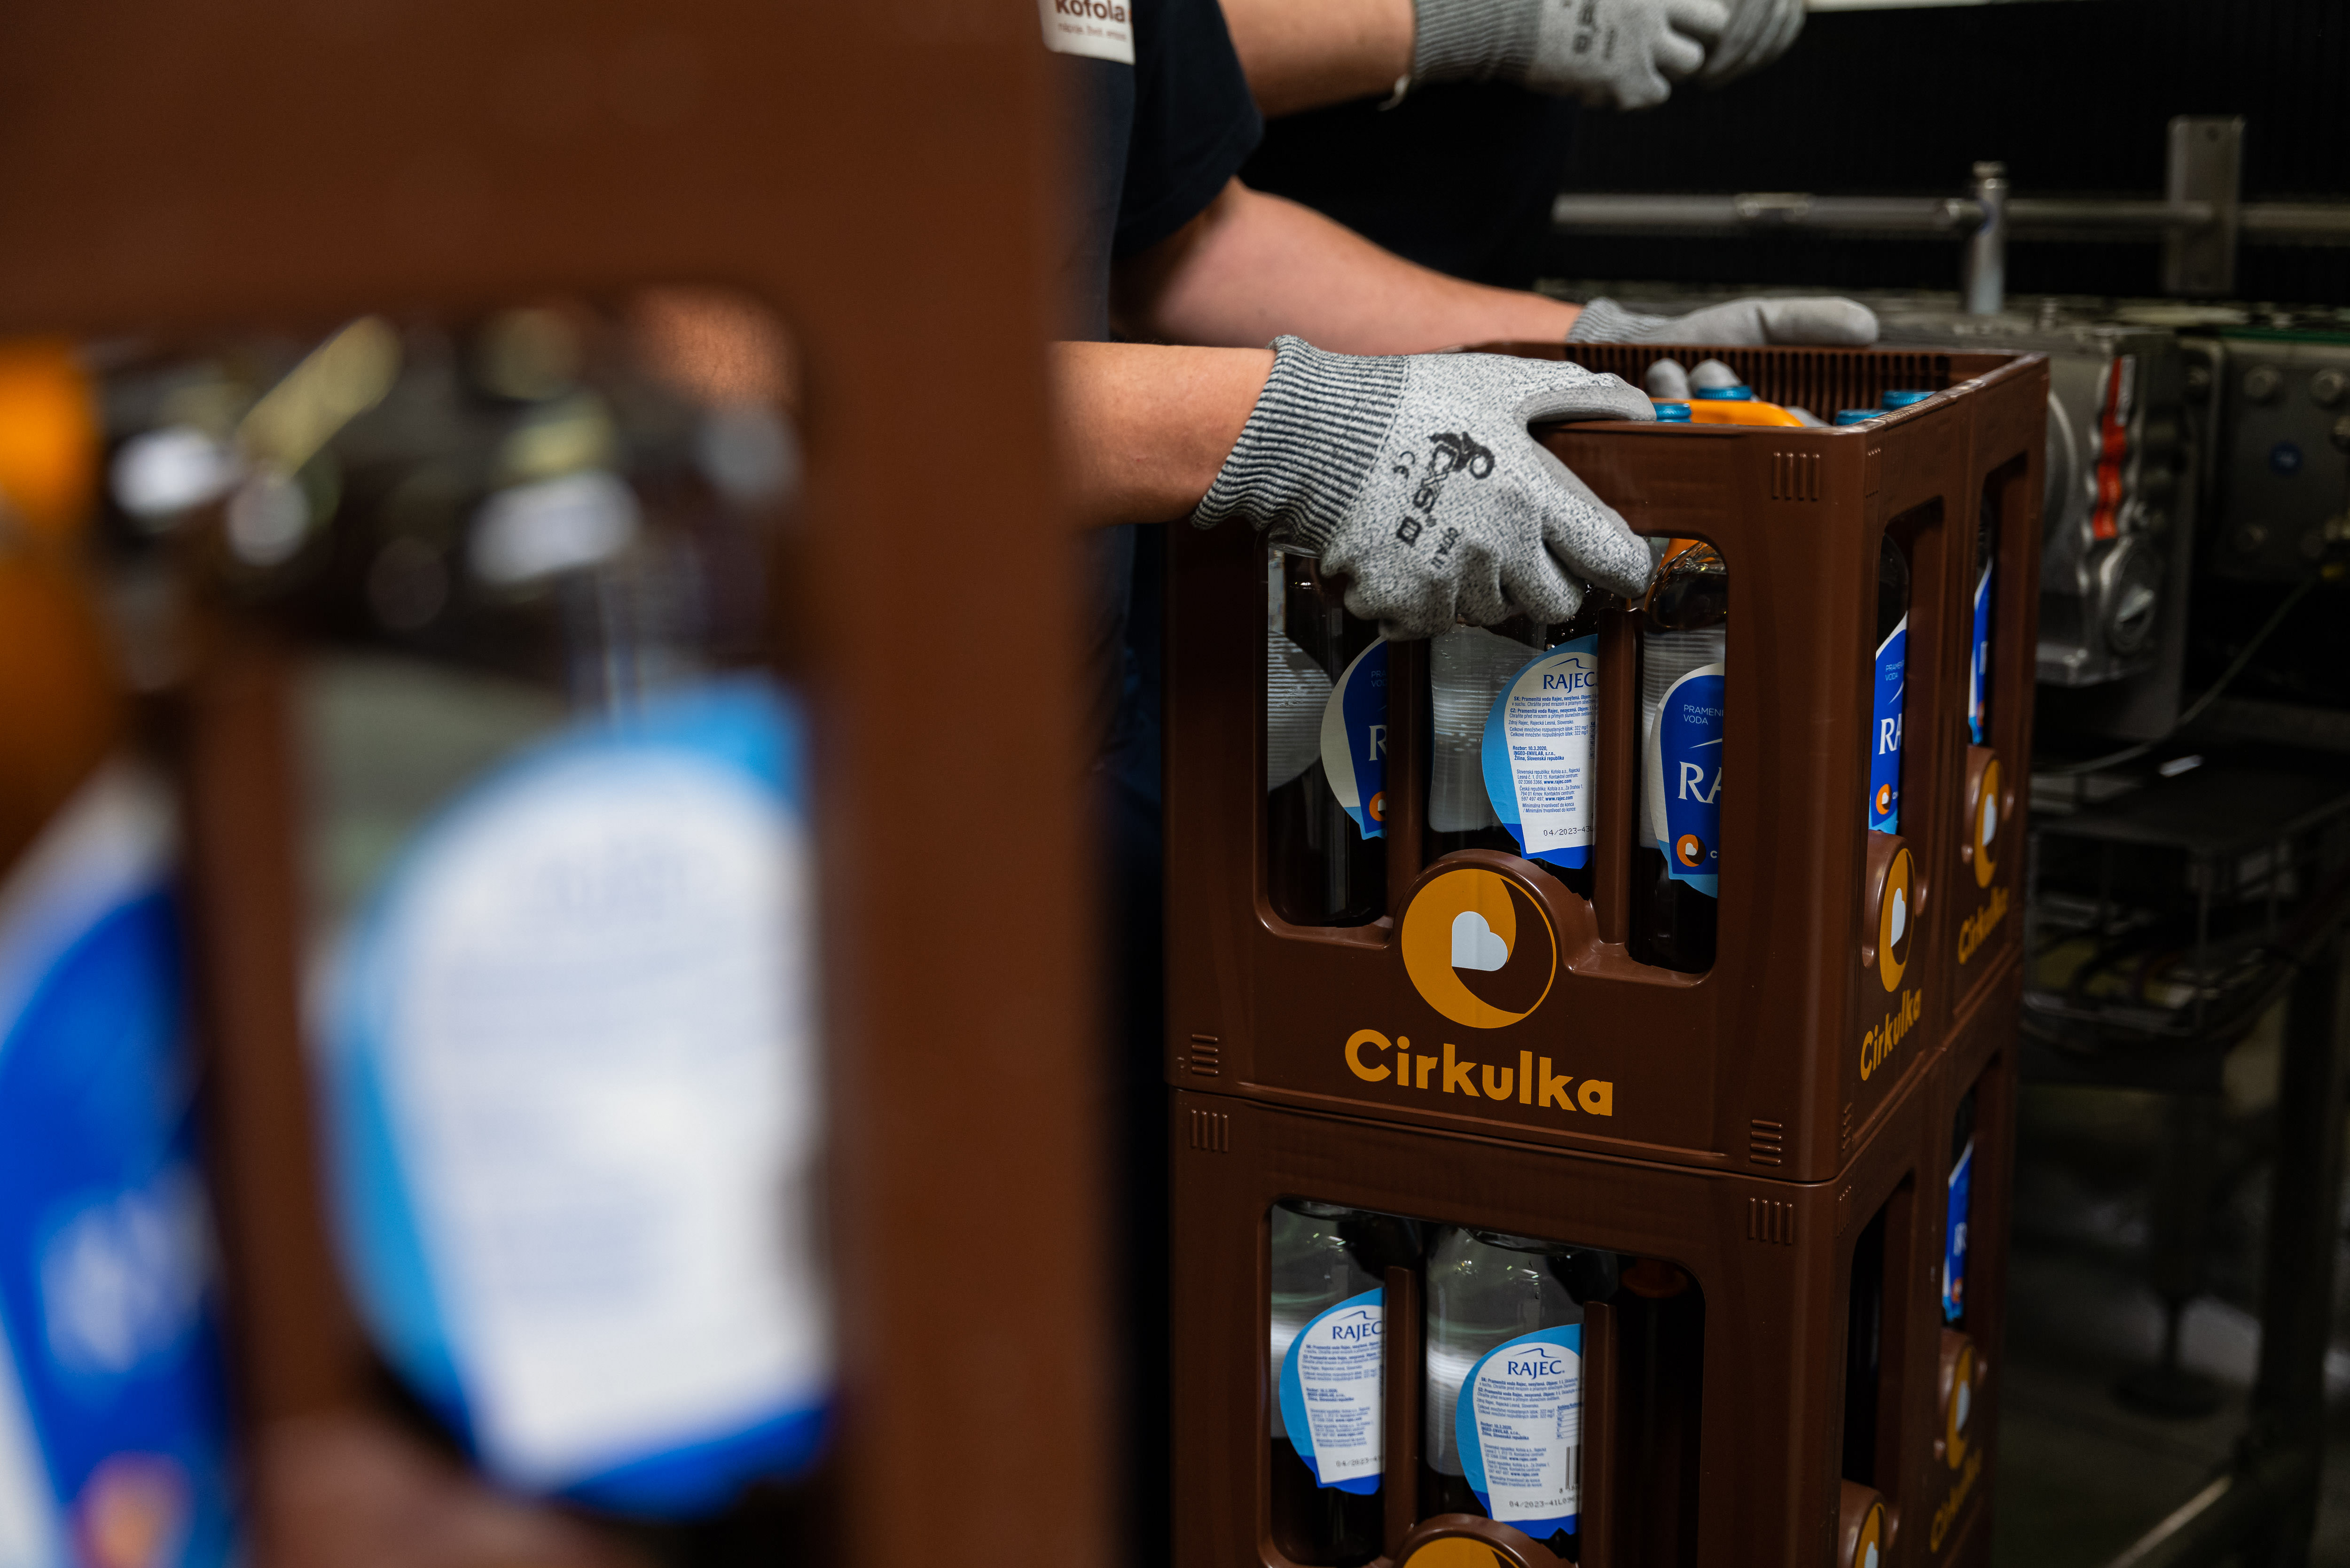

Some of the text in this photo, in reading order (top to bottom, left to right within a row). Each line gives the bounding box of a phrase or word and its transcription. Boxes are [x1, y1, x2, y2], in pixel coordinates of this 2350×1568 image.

[1543, 671, 1595, 694] RAJEC
[1684, 714, 1708, 725] VODA
[1860, 989, 1921, 1081] Cirkulka
[1345, 1029, 1613, 1116] Cirkulka
[1332, 1321, 1383, 1342] RAJEC
[1508, 1360, 1562, 1379] RAJEC
